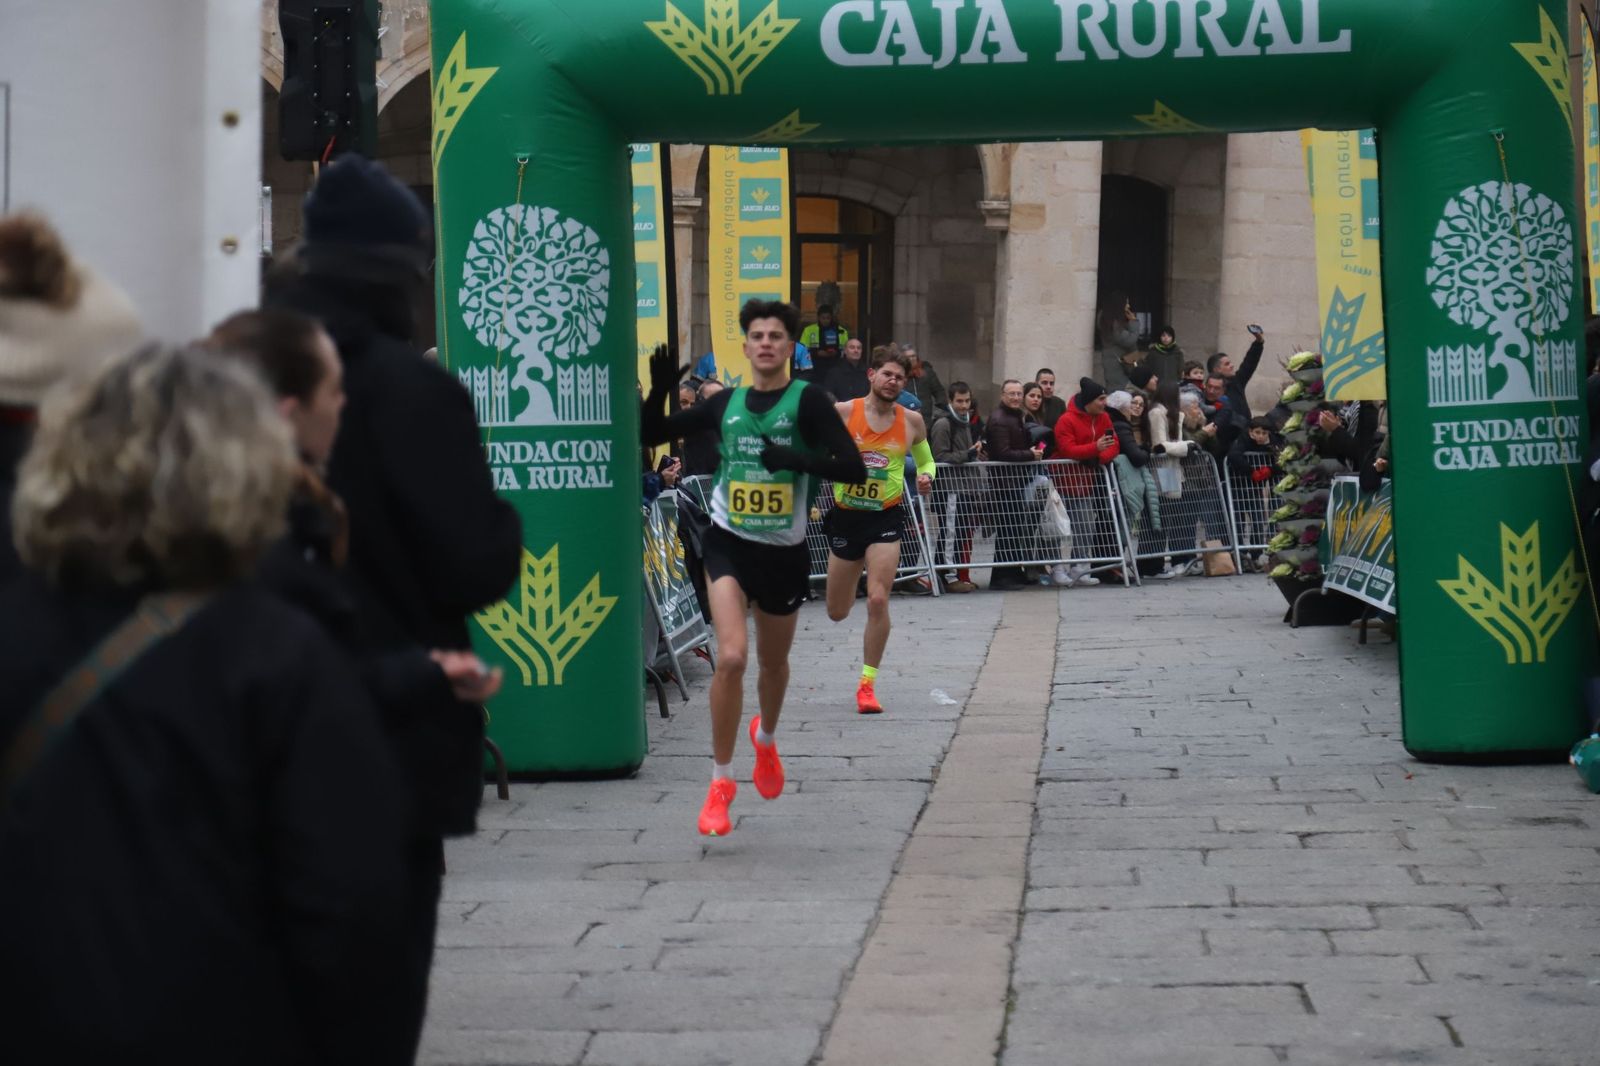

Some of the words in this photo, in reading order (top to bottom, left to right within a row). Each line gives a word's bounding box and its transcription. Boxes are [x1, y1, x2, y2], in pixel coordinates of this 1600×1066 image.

[819, 0, 1028, 70] CAJA
[1055, 0, 1352, 62] RURAL
[738, 435, 792, 446] univeidad
[1432, 415, 1580, 444] FUNDACION
[864, 456, 888, 465] errano
[1434, 445, 1502, 471] CAJA
[1506, 441, 1582, 467] RURAL
[490, 467, 521, 491] JA
[527, 465, 613, 489] RURAL
[847, 483, 879, 499] 756
[733, 488, 783, 514] 695
